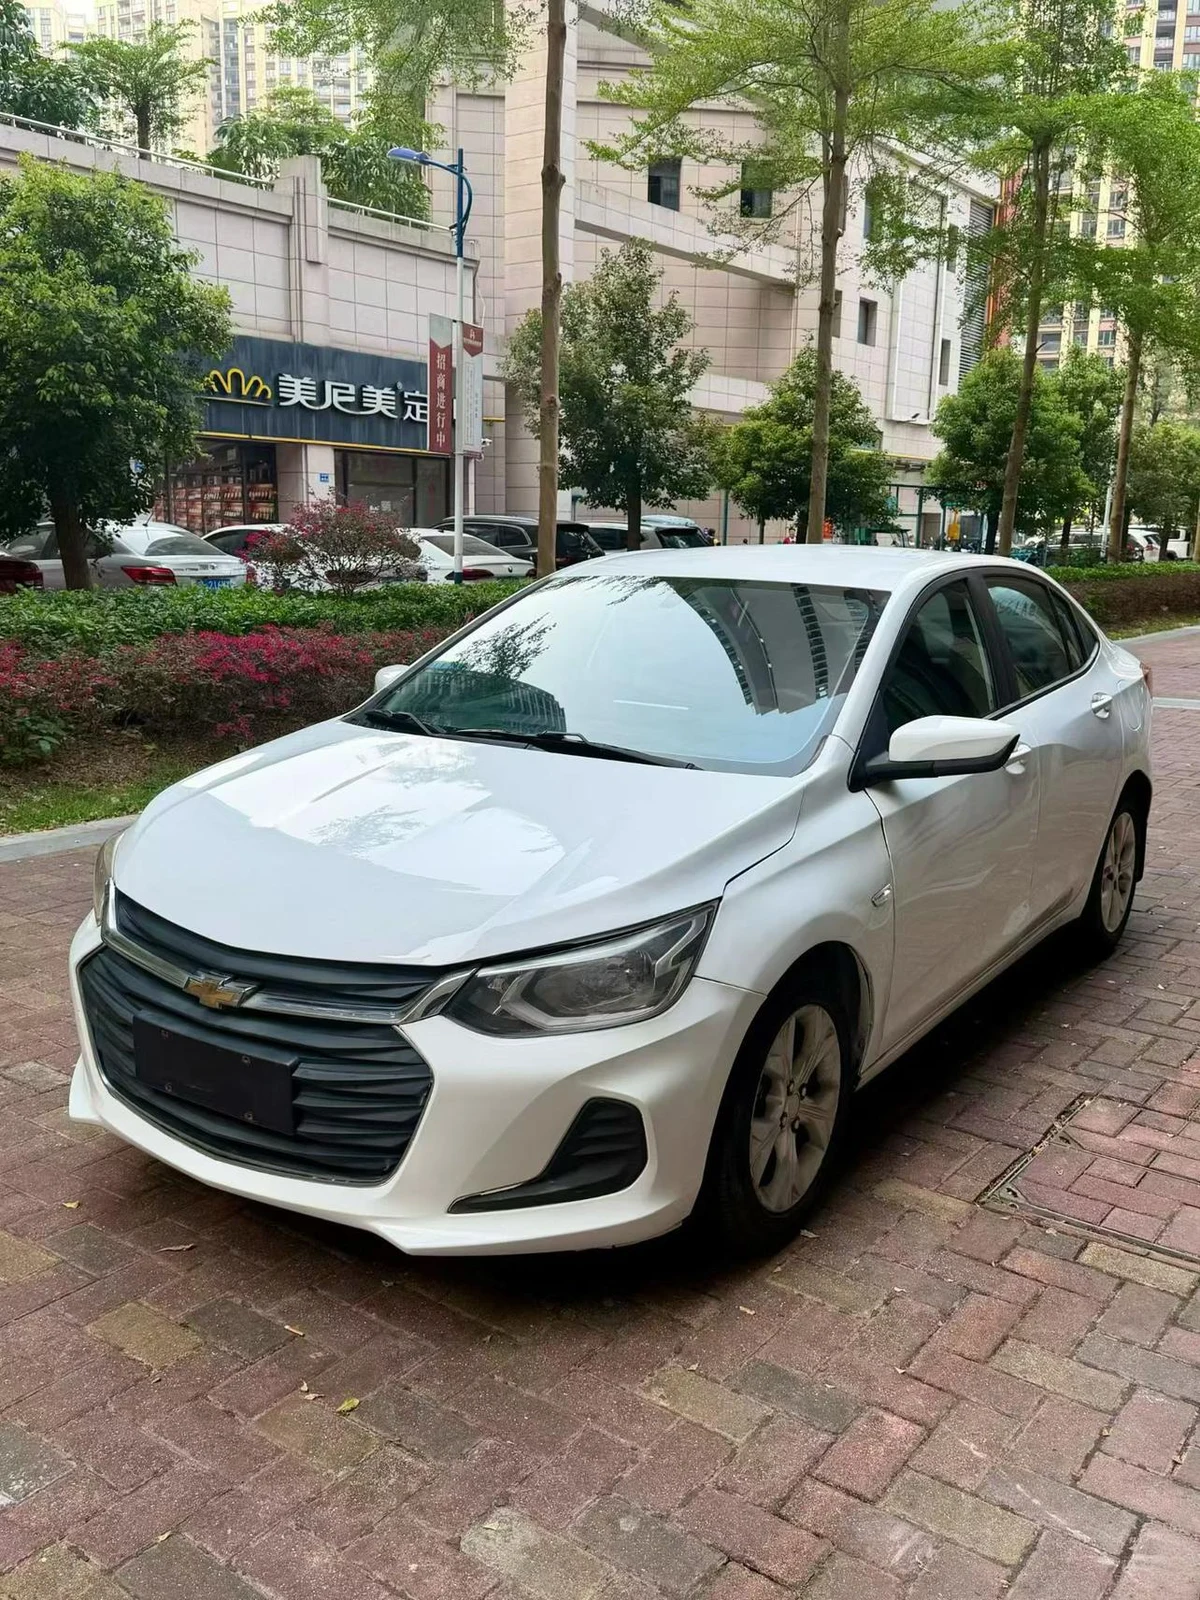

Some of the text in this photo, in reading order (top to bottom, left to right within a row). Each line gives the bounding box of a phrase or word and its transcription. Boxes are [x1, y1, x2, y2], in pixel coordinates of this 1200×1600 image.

[436, 352, 446, 448] 招商进行中
